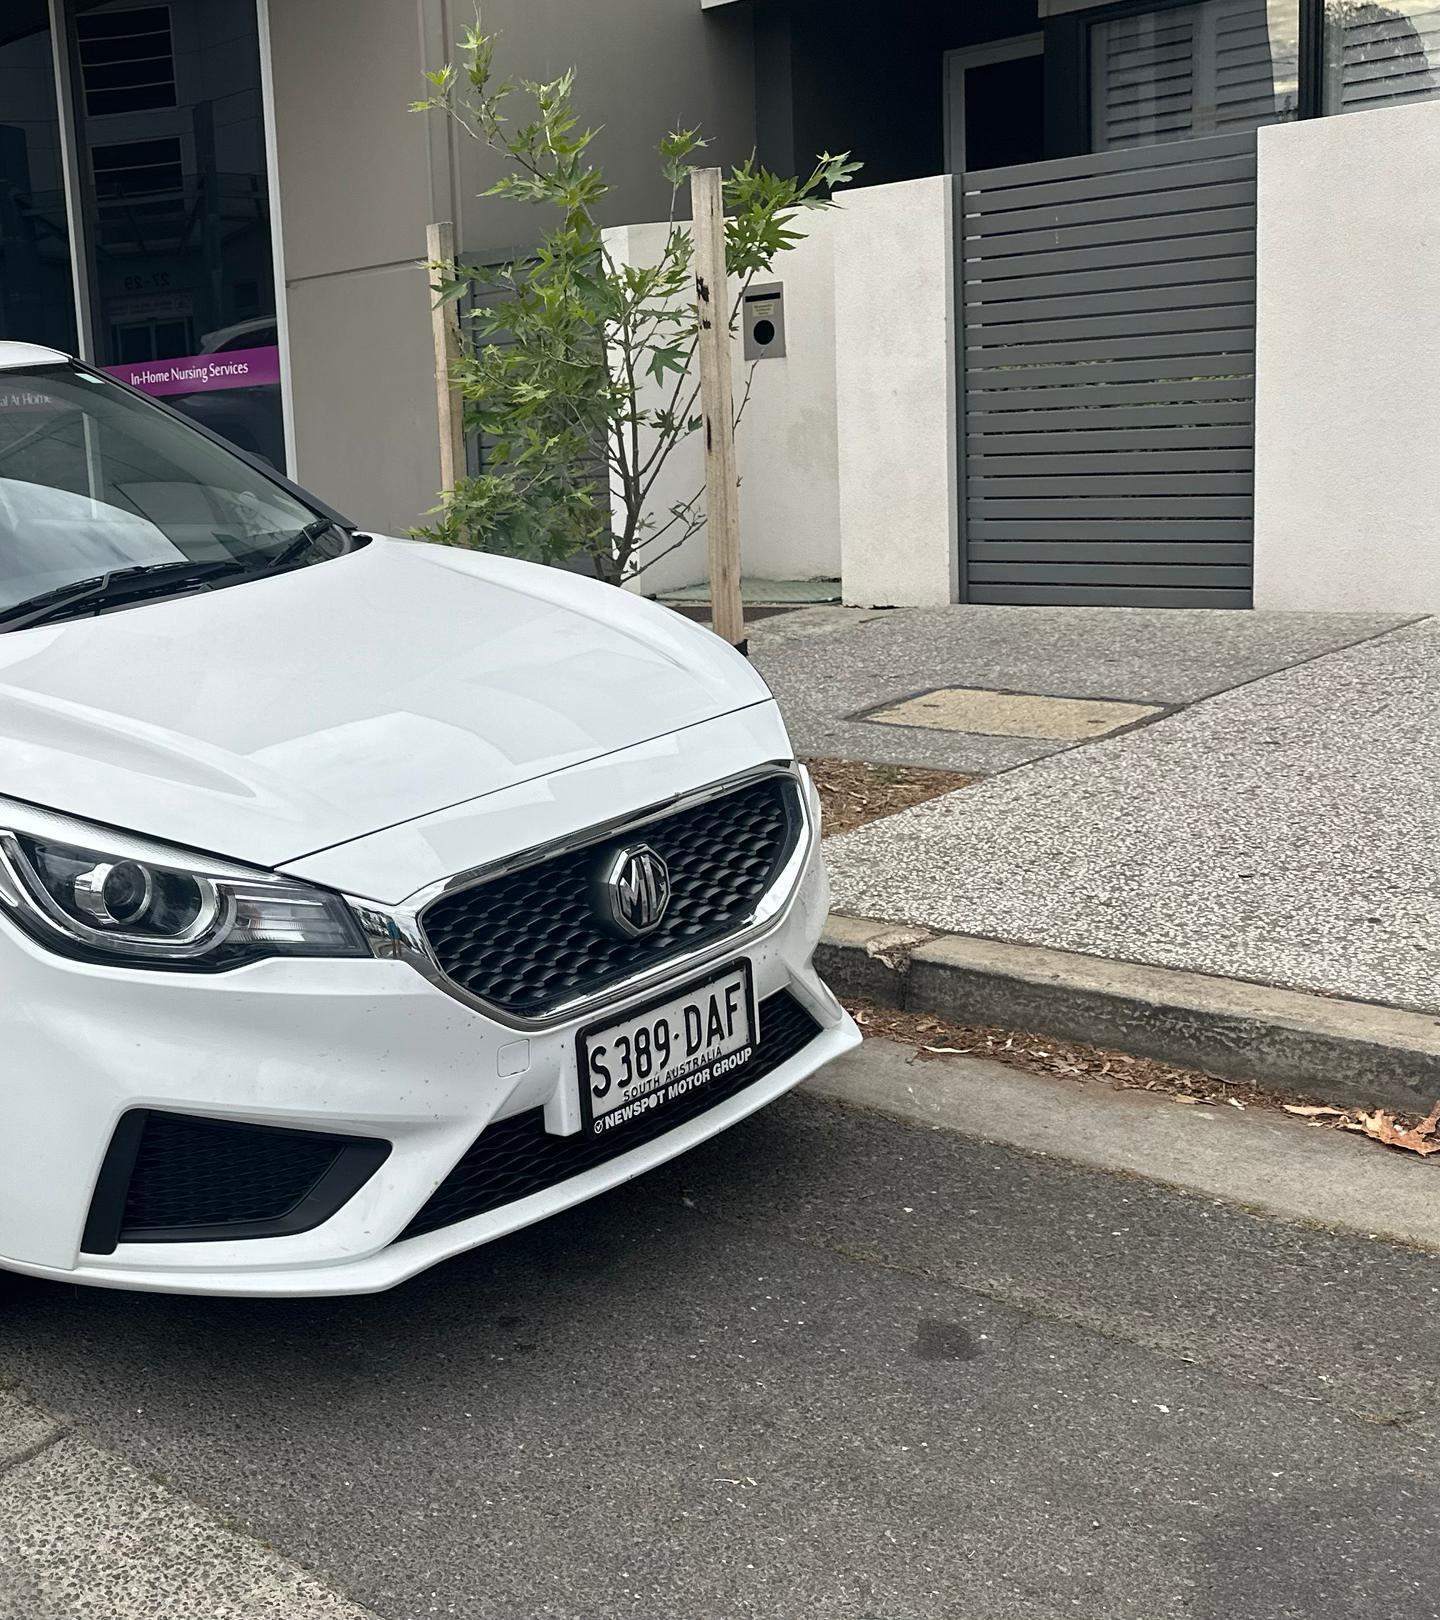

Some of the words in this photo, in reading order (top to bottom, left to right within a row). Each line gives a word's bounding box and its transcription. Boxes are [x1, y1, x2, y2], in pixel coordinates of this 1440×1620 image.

[130, 371, 170, 386] In-Home
[171, 366, 208, 383] Nursing
[209, 361, 249, 377] Services
[617, 851, 667, 927] MG
[604, 1090, 666, 1130] NEWSPOT
[668, 1068, 711, 1100] MOTOR
[712, 1047, 753, 1077] GROUP
[623, 1074, 660, 1102] SOUTH
[665, 1046, 722, 1083] AUSTRALIA
